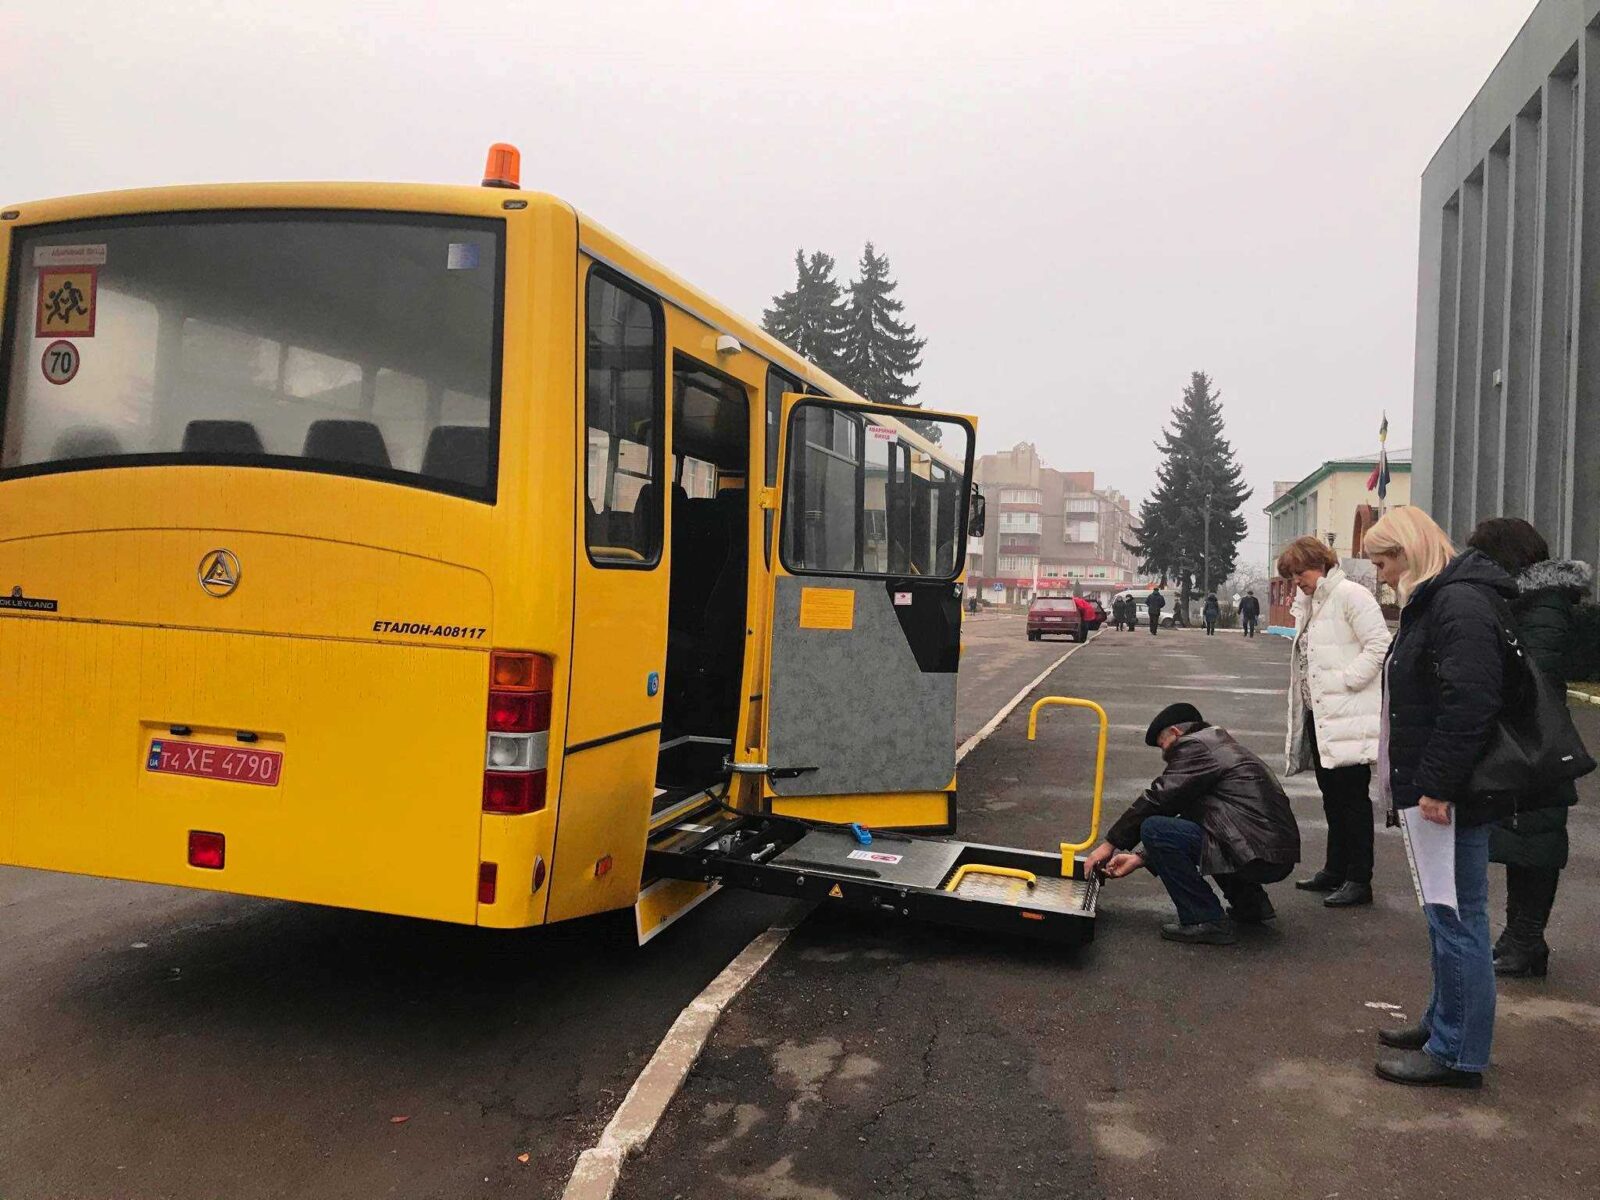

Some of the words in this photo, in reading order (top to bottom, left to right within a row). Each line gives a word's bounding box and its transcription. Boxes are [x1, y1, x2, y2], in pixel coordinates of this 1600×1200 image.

[50, 351, 72, 375] 70
[12, 600, 55, 609] LEYLAND
[373, 620, 486, 639] ЕТАЛОН-А08117
[149, 758, 159, 767] UA
[221, 752, 273, 780] 4790
